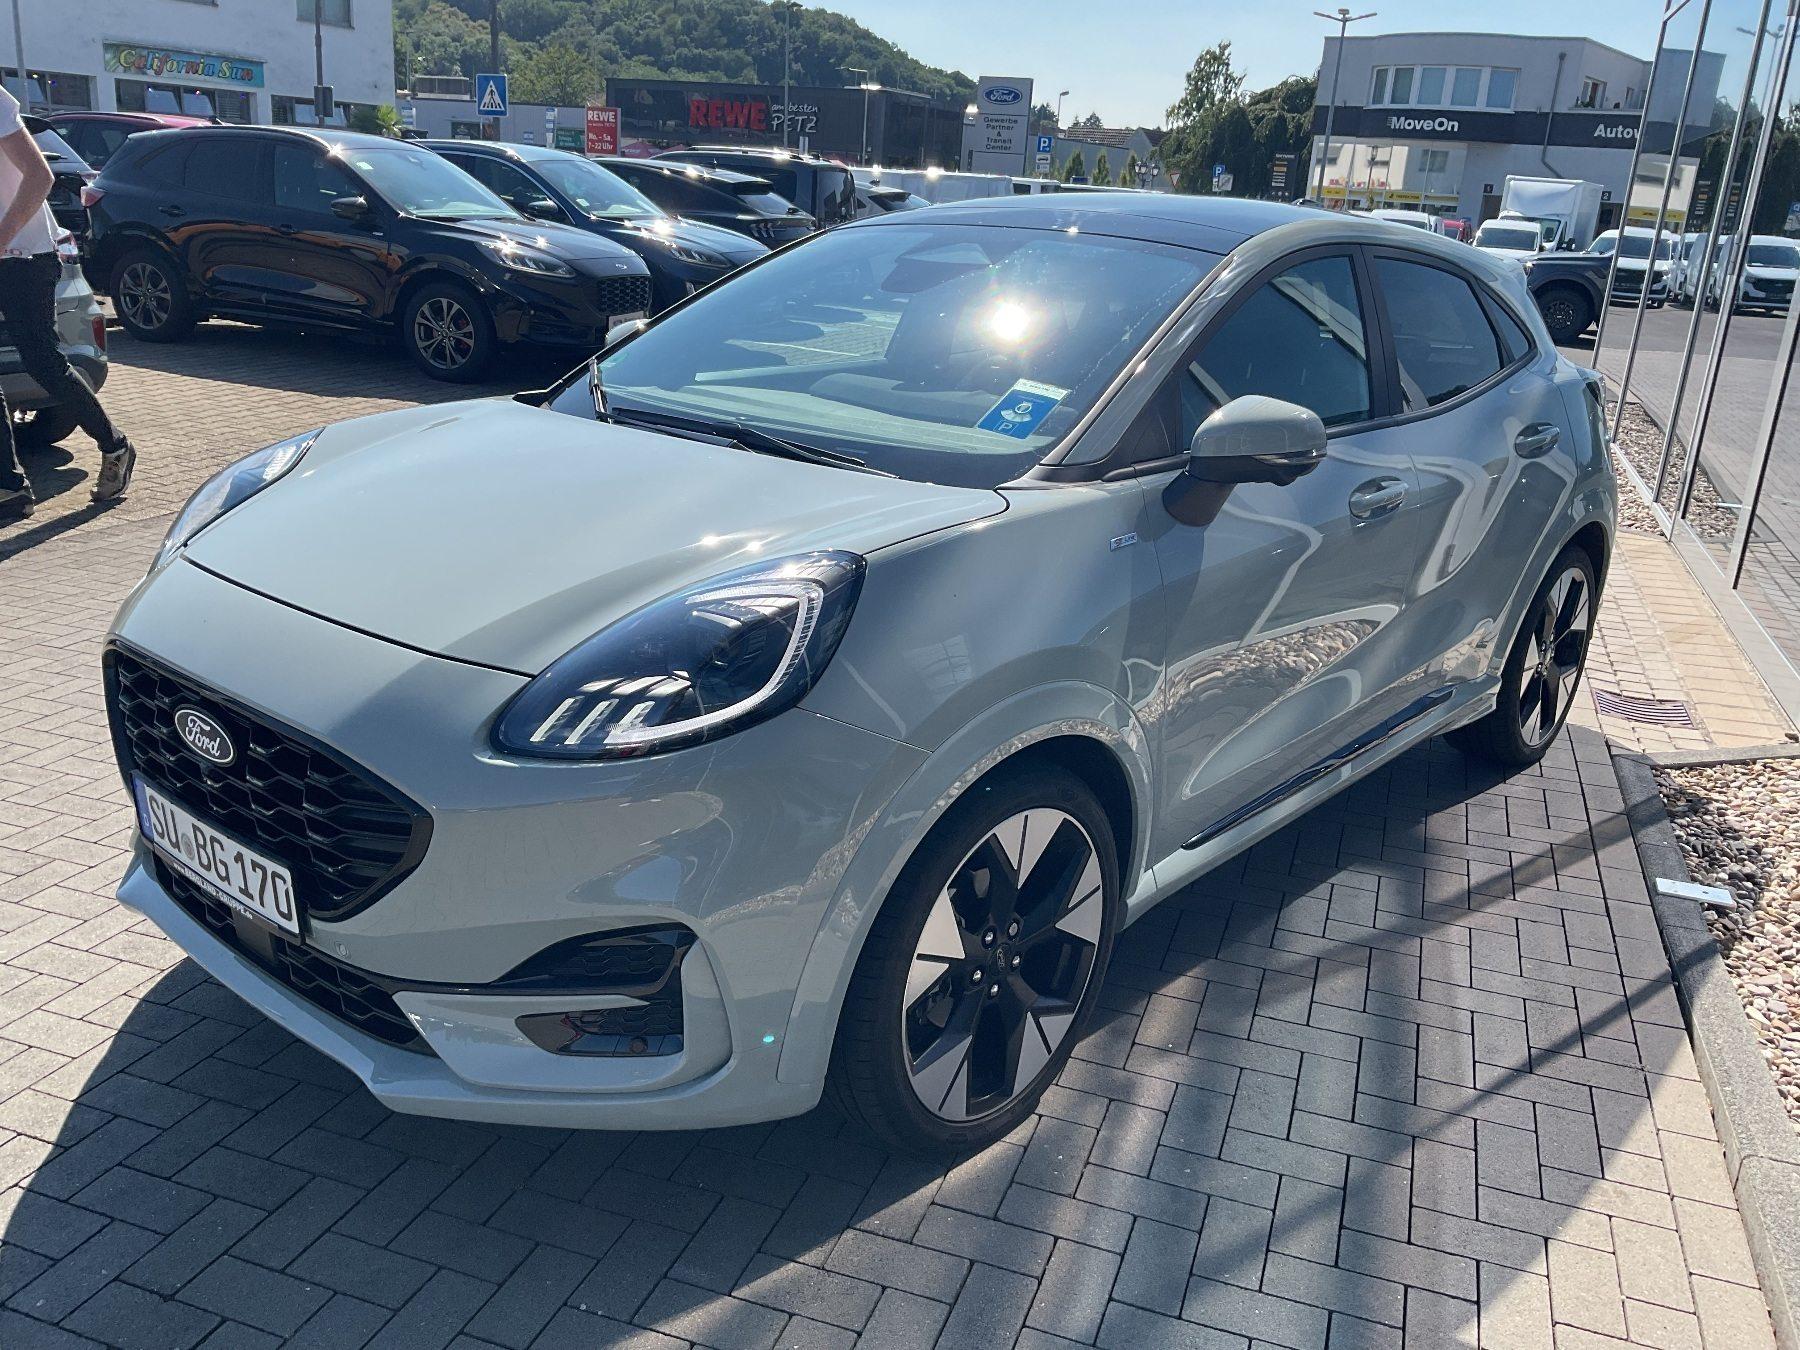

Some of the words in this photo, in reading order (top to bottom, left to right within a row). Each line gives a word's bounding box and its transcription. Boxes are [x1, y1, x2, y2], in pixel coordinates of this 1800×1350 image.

[119, 49, 215, 76] California
[218, 60, 254, 81] Sun
[990, 89, 1015, 102] Ford
[788, 102, 818, 113] besten
[587, 110, 616, 122] REWE
[689, 99, 768, 131] REWE
[983, 116, 1018, 124] Gewerbe
[771, 113, 817, 133] PETZ
[986, 123, 1014, 131] Partner
[1390, 116, 1459, 132] MoveOn
[1040, 138, 1049, 151] P
[1215, 166, 1222, 177] P
[1603, 192, 1609, 200] 2
[998, 422, 1013, 431] P
[185, 715, 221, 757] Ford
[149, 794, 181, 854] SU
[191, 822, 231, 887] BG
[234, 850, 293, 922] 170
